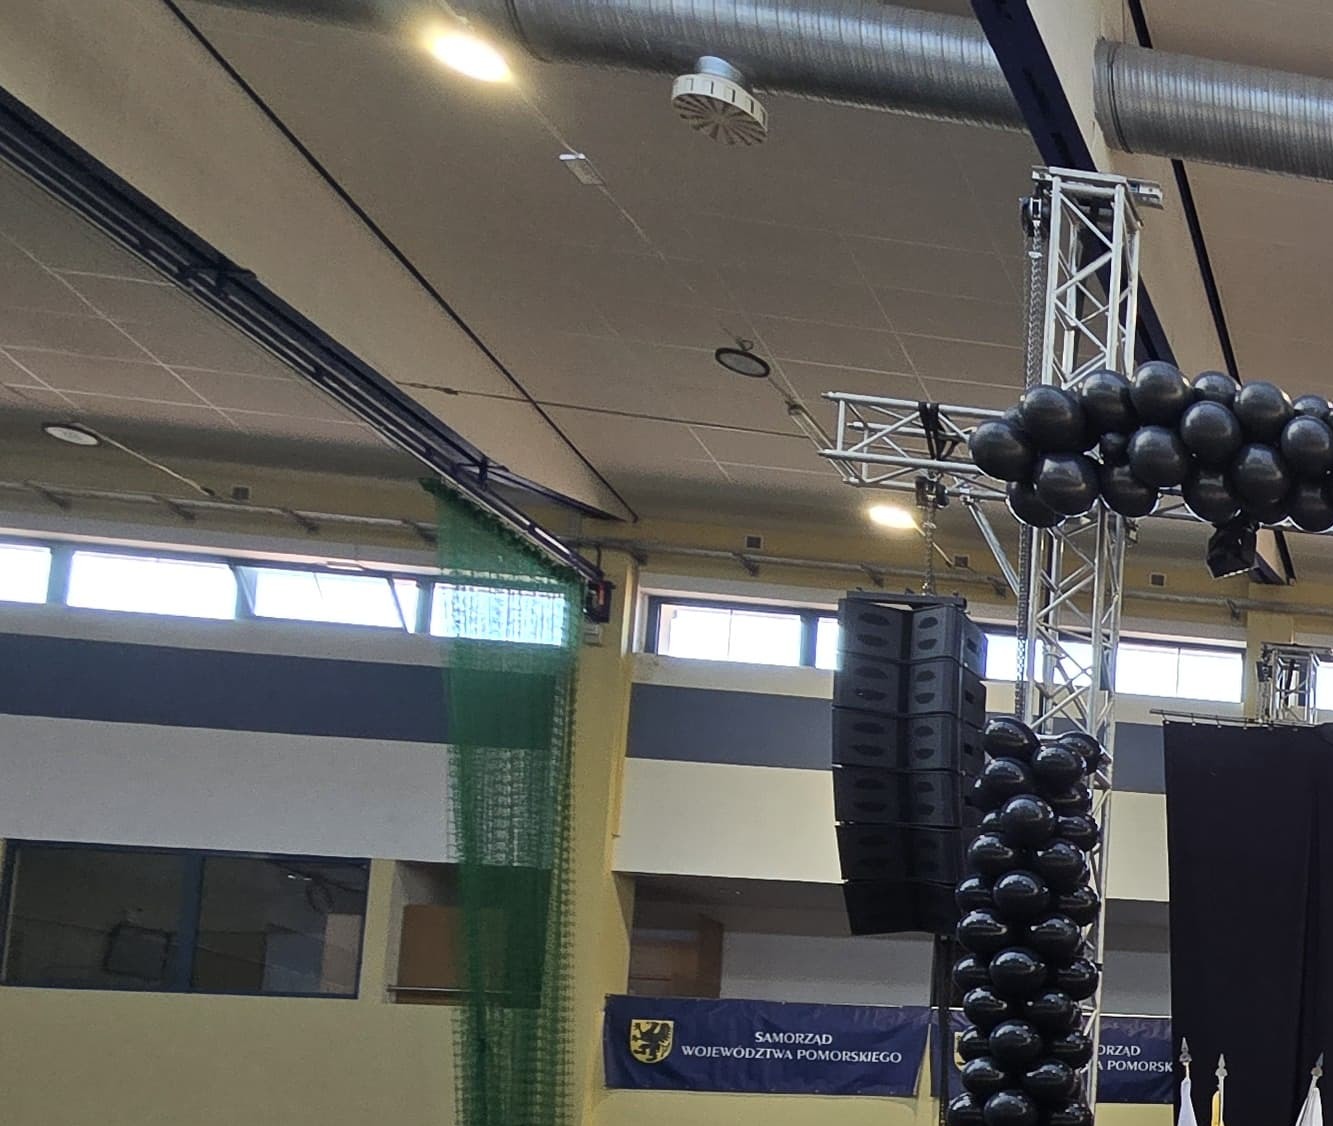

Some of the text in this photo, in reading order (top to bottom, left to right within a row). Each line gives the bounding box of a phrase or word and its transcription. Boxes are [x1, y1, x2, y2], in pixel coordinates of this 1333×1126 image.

[754, 1031, 833, 1046] SAMORZĄD
[681, 1045, 902, 1063] WOJEWÓDZTWA POMORSKIEGO
[1098, 1044, 1141, 1057] ORZĄD
[1107, 1060, 1173, 1072] POMORSK
